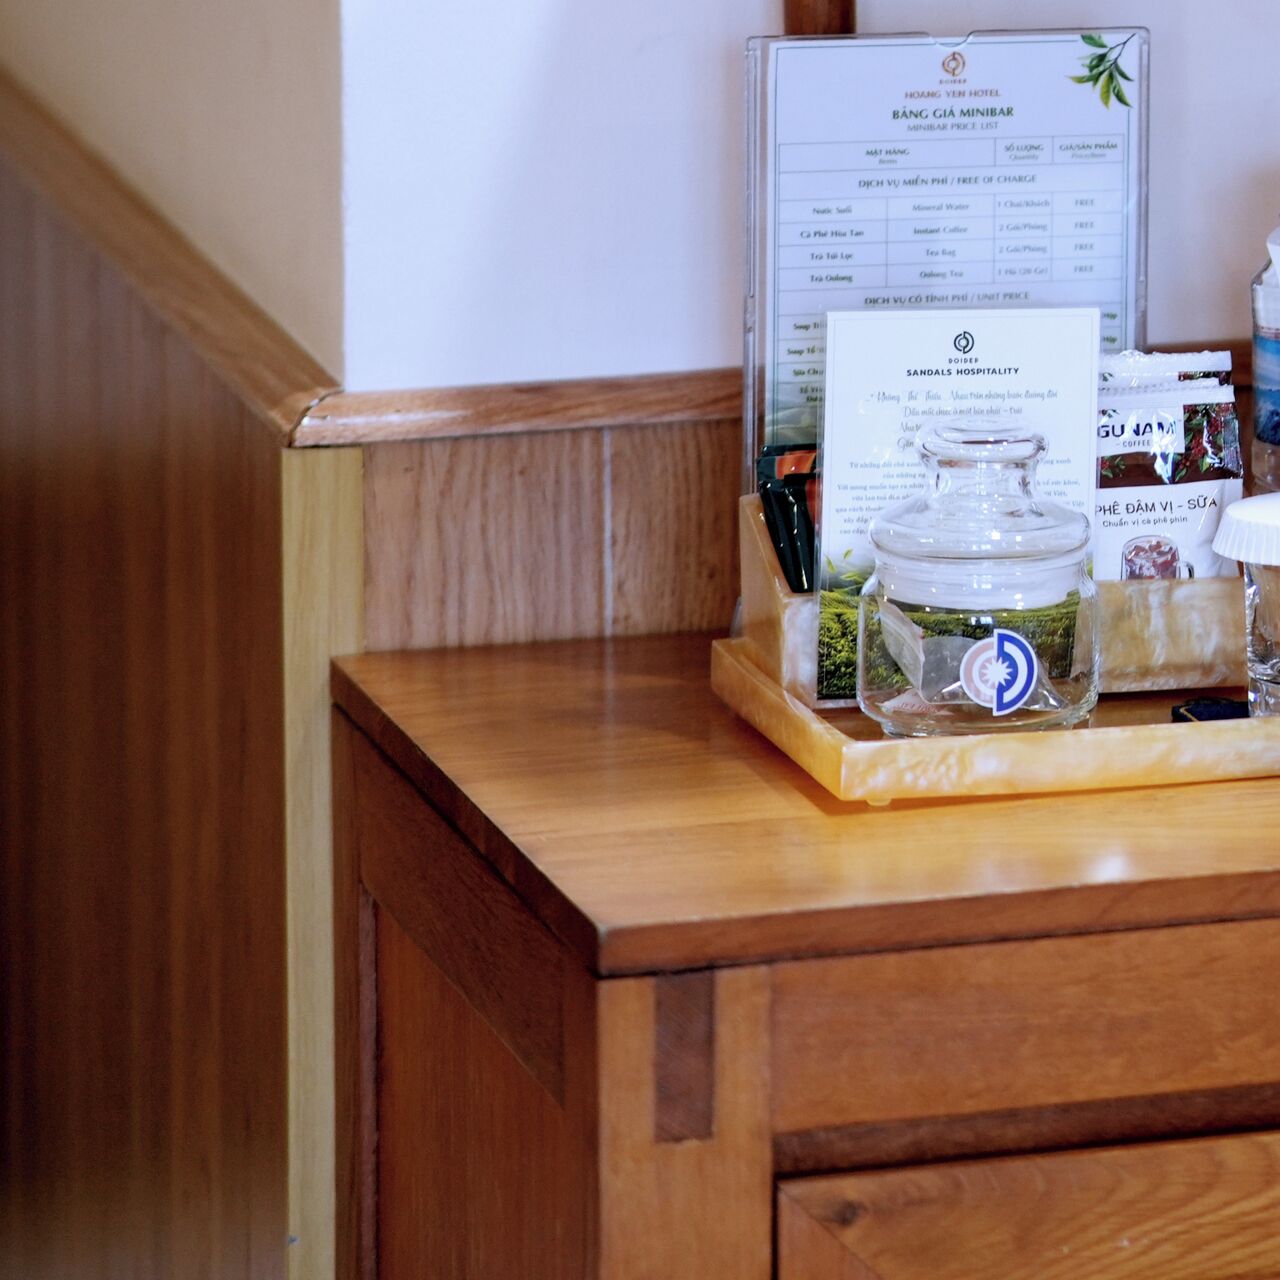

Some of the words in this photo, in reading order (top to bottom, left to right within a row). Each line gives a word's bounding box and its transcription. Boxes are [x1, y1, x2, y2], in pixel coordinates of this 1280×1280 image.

[905, 90, 941, 99] HOANG
[946, 90, 965, 98] YEN
[969, 89, 1000, 97] HOTEL
[892, 106, 928, 119] BẢNG
[933, 106, 955, 119] GIÁ
[960, 107, 1014, 117] MINIBAR
[907, 122, 948, 132] MINIBAR
[951, 122, 976, 130] PRICE
[981, 121, 999, 129] LIST
[858, 179, 884, 189] DỊCH
[887, 179, 900, 188] VỤ
[932, 177, 948, 186] PHÍ
[957, 176, 979, 184] FREE
[983, 175, 994, 184] OF
[997, 174, 1037, 183] CHARGE
[912, 202, 943, 211] Mineral
[946, 202, 969, 210] Water
[914, 226, 940, 234] Instant
[1074, 221, 1094, 229] FREE
[926, 248, 939, 256] Tea
[1074, 243, 1094, 251] FREE
[1074, 265, 1094, 273] FREE
[864, 297, 890, 306] DỊCH
[893, 296, 905, 305] VỤ
[908, 294, 922, 303] CÓ
[952, 293, 968, 302] PHÍ
[978, 293, 1000, 301] UNIT
[1003, 292, 1029, 300] PRICE
[907, 369, 952, 377] SANDALS
[956, 367, 1019, 376] HOSPITALITY
[1126, 499, 1156, 516] ĐẬM
[1160, 500, 1173, 514] VỊ
[1187, 494, 1217, 509] SỮA
[1131, 518, 1139, 526] vị
[1170, 516, 1187, 526] phin
